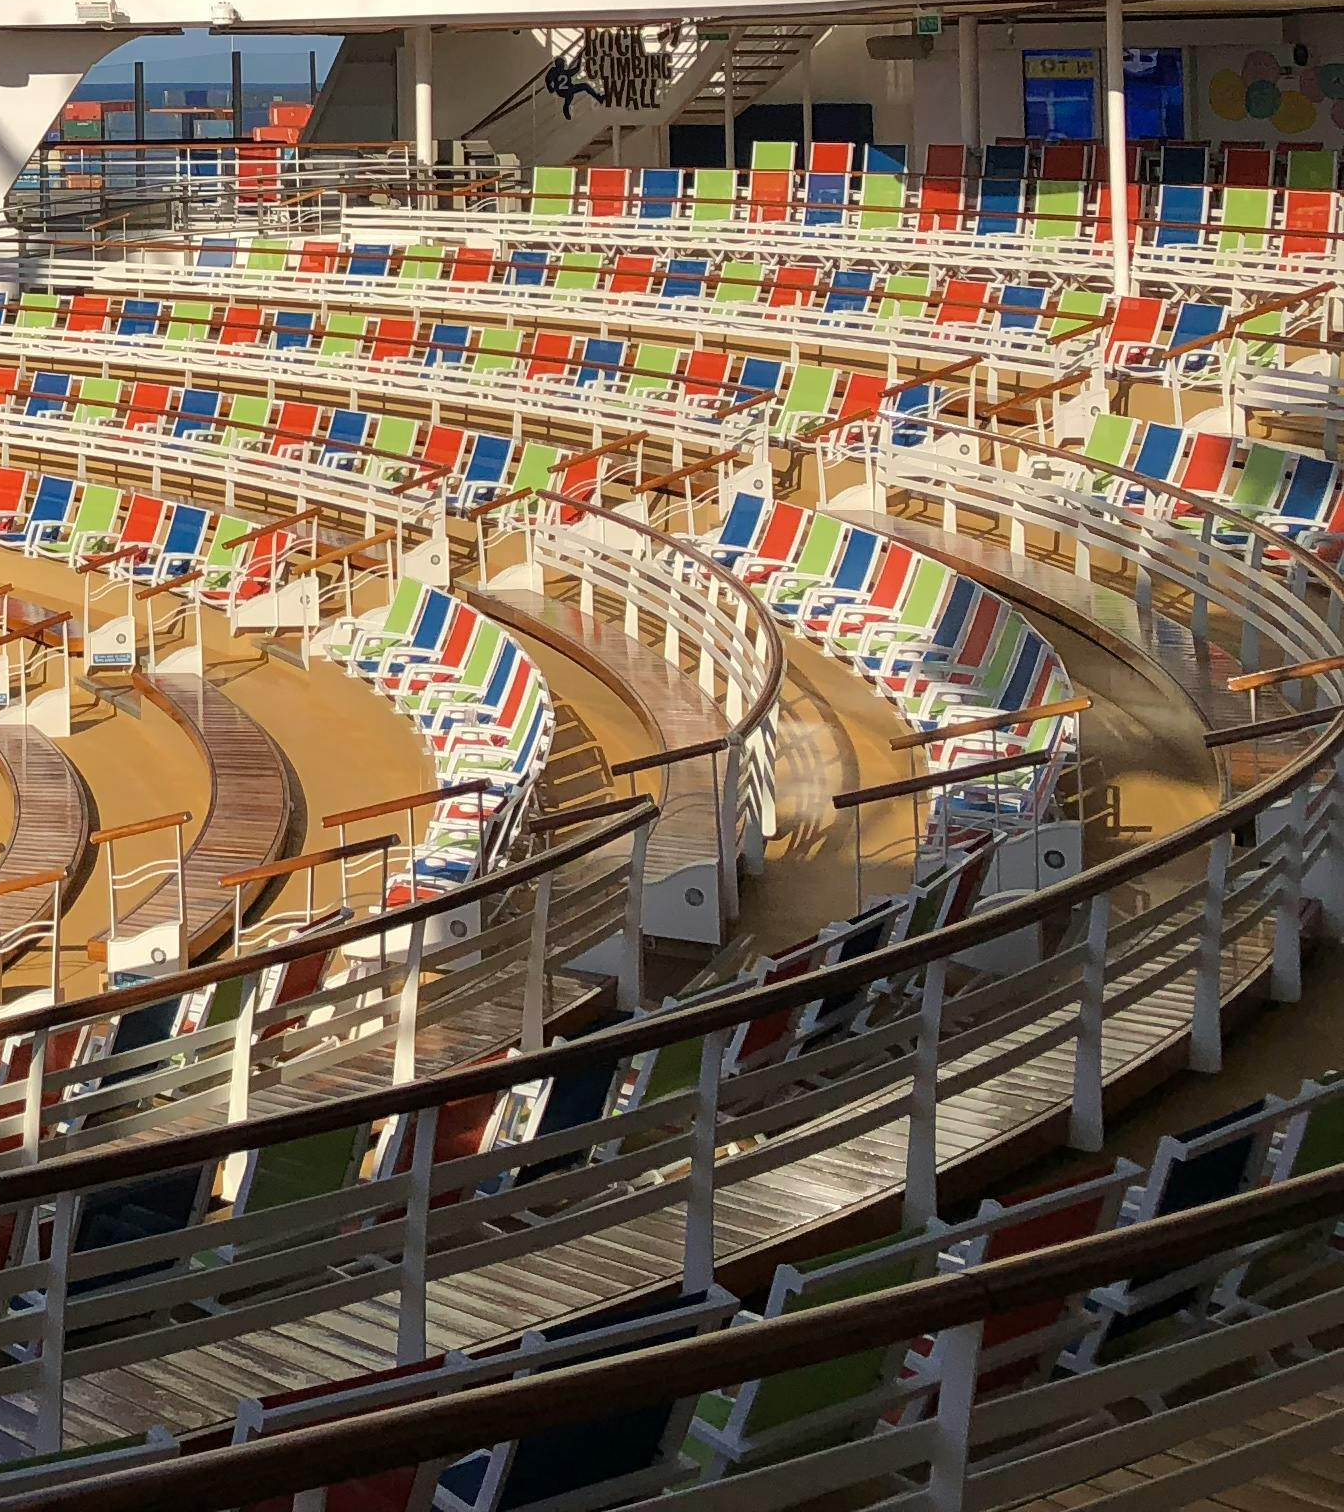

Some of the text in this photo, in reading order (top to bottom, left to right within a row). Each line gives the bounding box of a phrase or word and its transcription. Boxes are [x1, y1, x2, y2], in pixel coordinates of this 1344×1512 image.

[585, 26, 646, 57] ROCK
[585, 53, 672, 80] CLIMBING
[557, 75, 569, 89] 2
[603, 76, 660, 110] WALL
